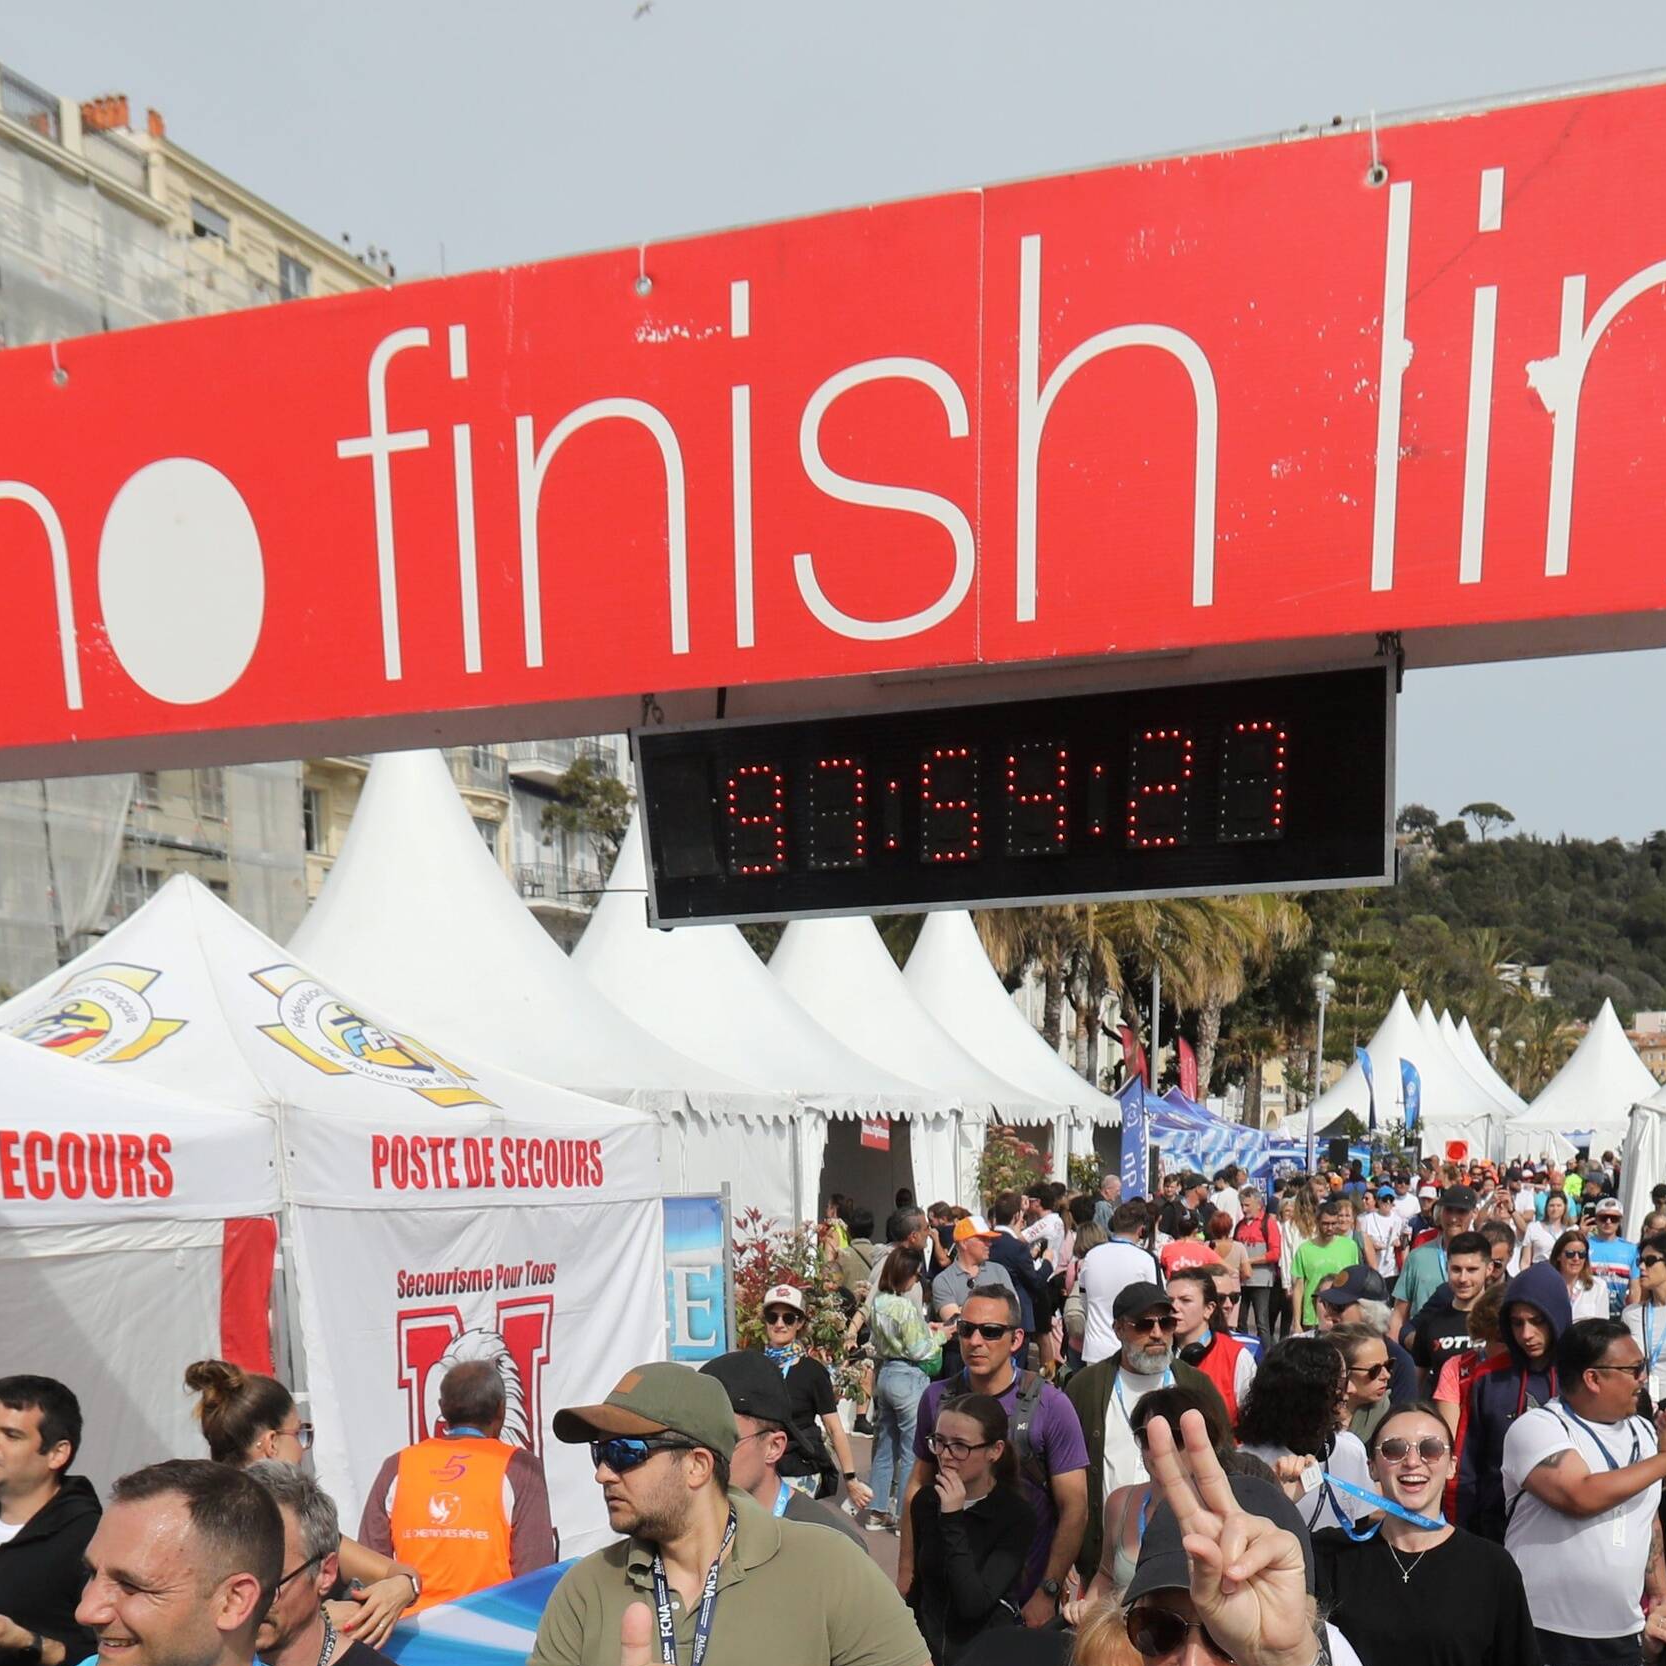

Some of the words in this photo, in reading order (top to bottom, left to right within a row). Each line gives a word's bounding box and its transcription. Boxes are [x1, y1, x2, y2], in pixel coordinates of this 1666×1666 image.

[336, 233, 1218, 681] finish
[371, 1134, 458, 1190] POSTE
[463, 1137, 497, 1188] DE
[500, 1137, 604, 1188] SECOURS
[396, 1266, 493, 1299] Secourisme
[495, 1264, 522, 1292] Pour
[525, 1260, 557, 1286] Tous
[438, 1455, 474, 1482] 5
[702, 1564, 719, 1599] FCNA
[658, 1604, 673, 1637] FCNA
